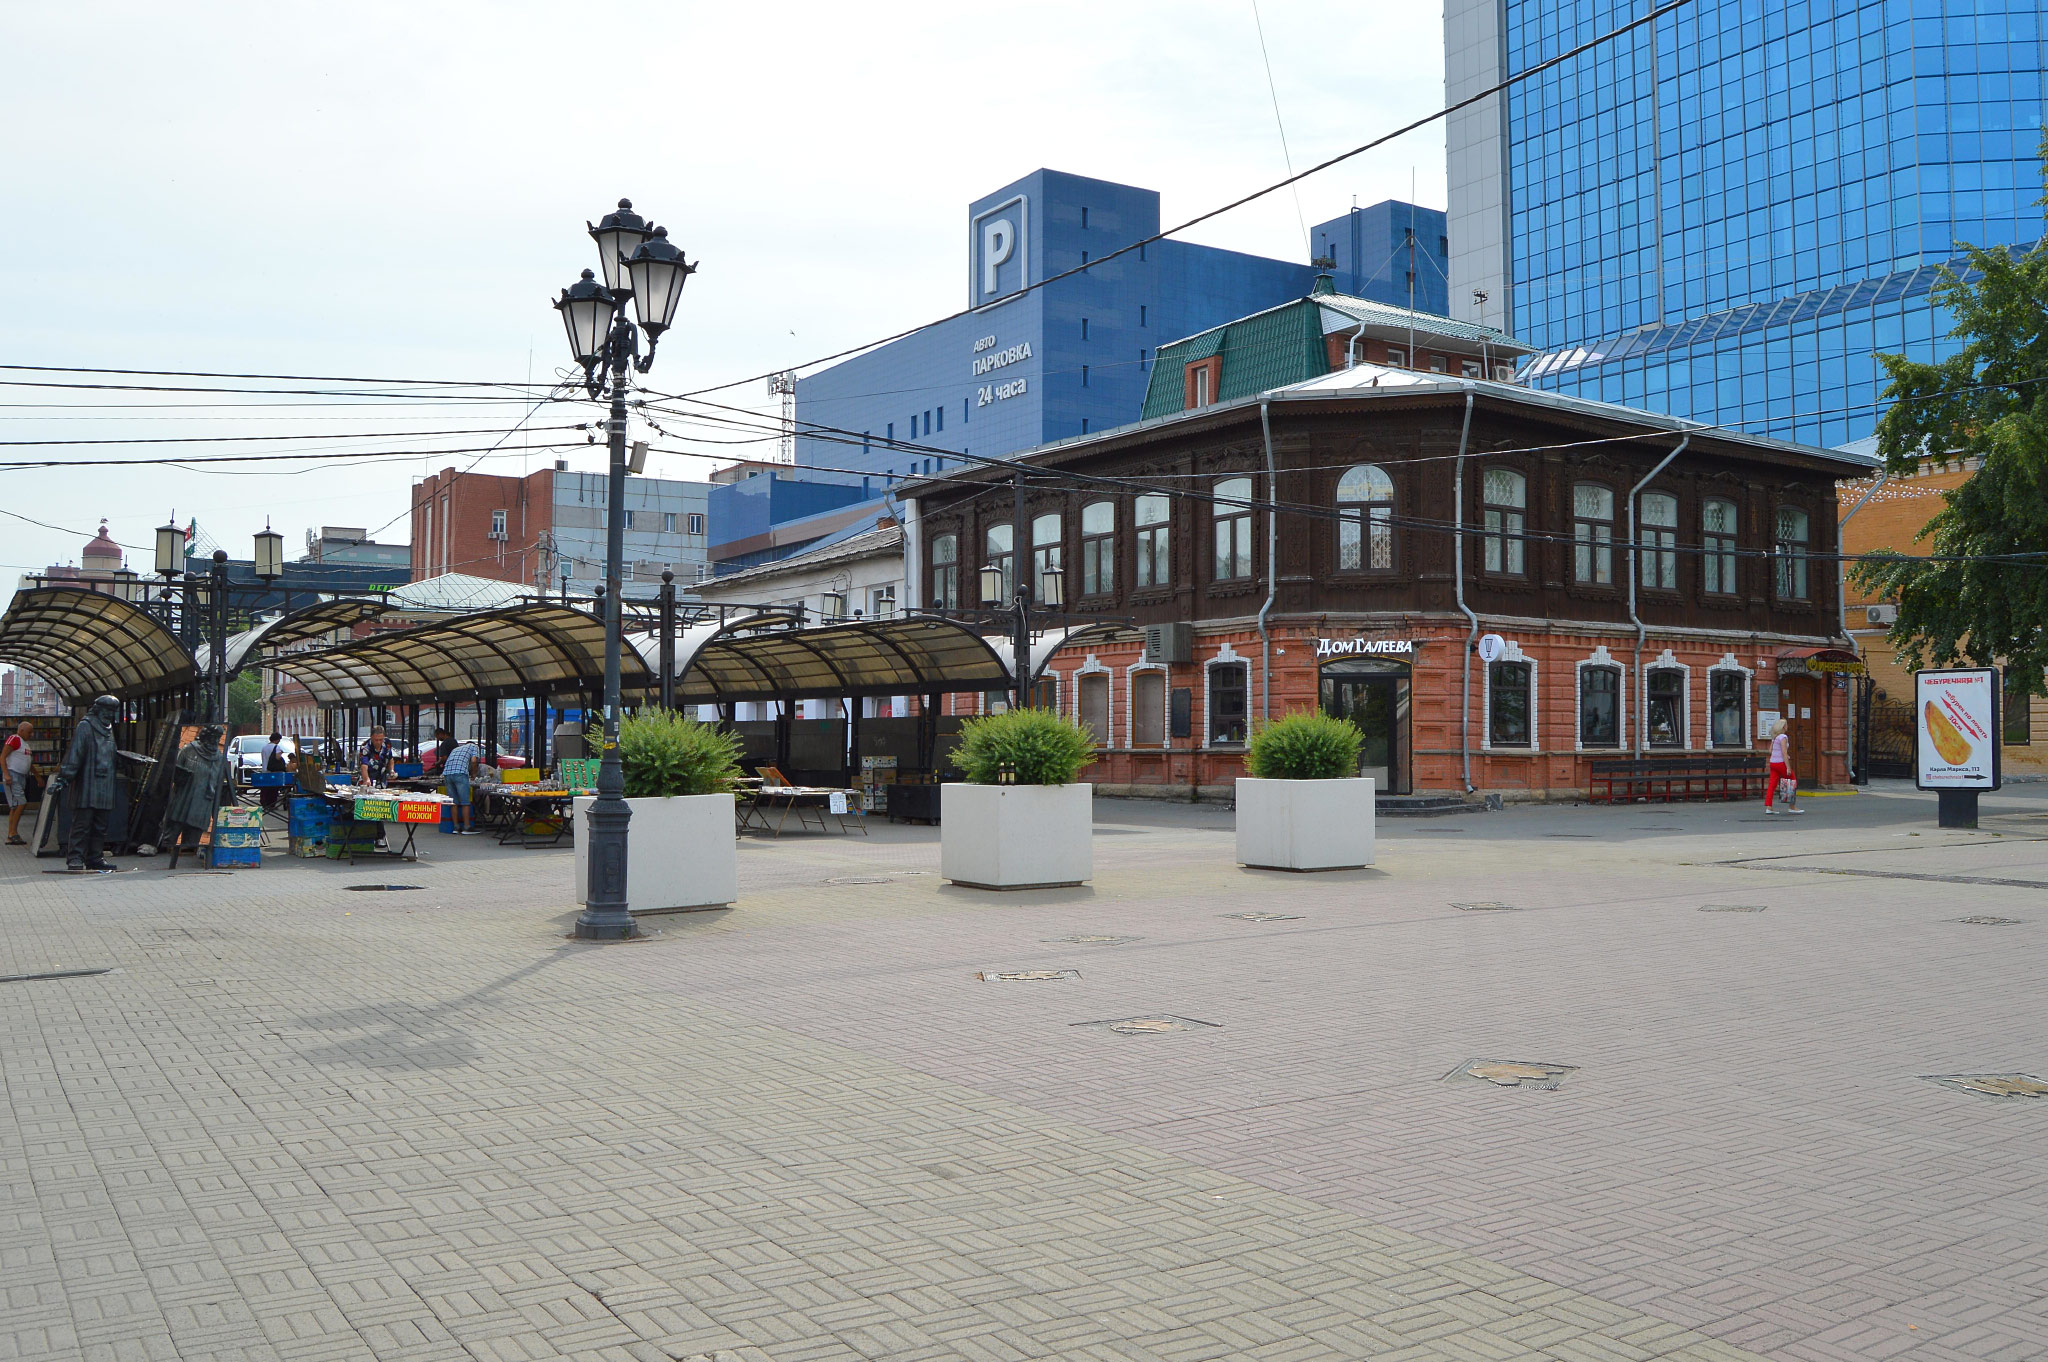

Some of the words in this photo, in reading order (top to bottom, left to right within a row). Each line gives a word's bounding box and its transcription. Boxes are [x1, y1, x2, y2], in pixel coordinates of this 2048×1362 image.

[985, 219, 1014, 294] P
[972, 342, 1032, 376] ПАРКОВКА
[973, 335, 996, 354] АВТО
[977, 385, 994, 407] 24
[995, 378, 1027, 401] часа
[1945, 690, 1964, 712] чебурек
[1964, 711, 1972, 719] по
[1948, 715, 1963, 732] 30см
[402, 804, 437, 812] ИМЕННЫЕ
